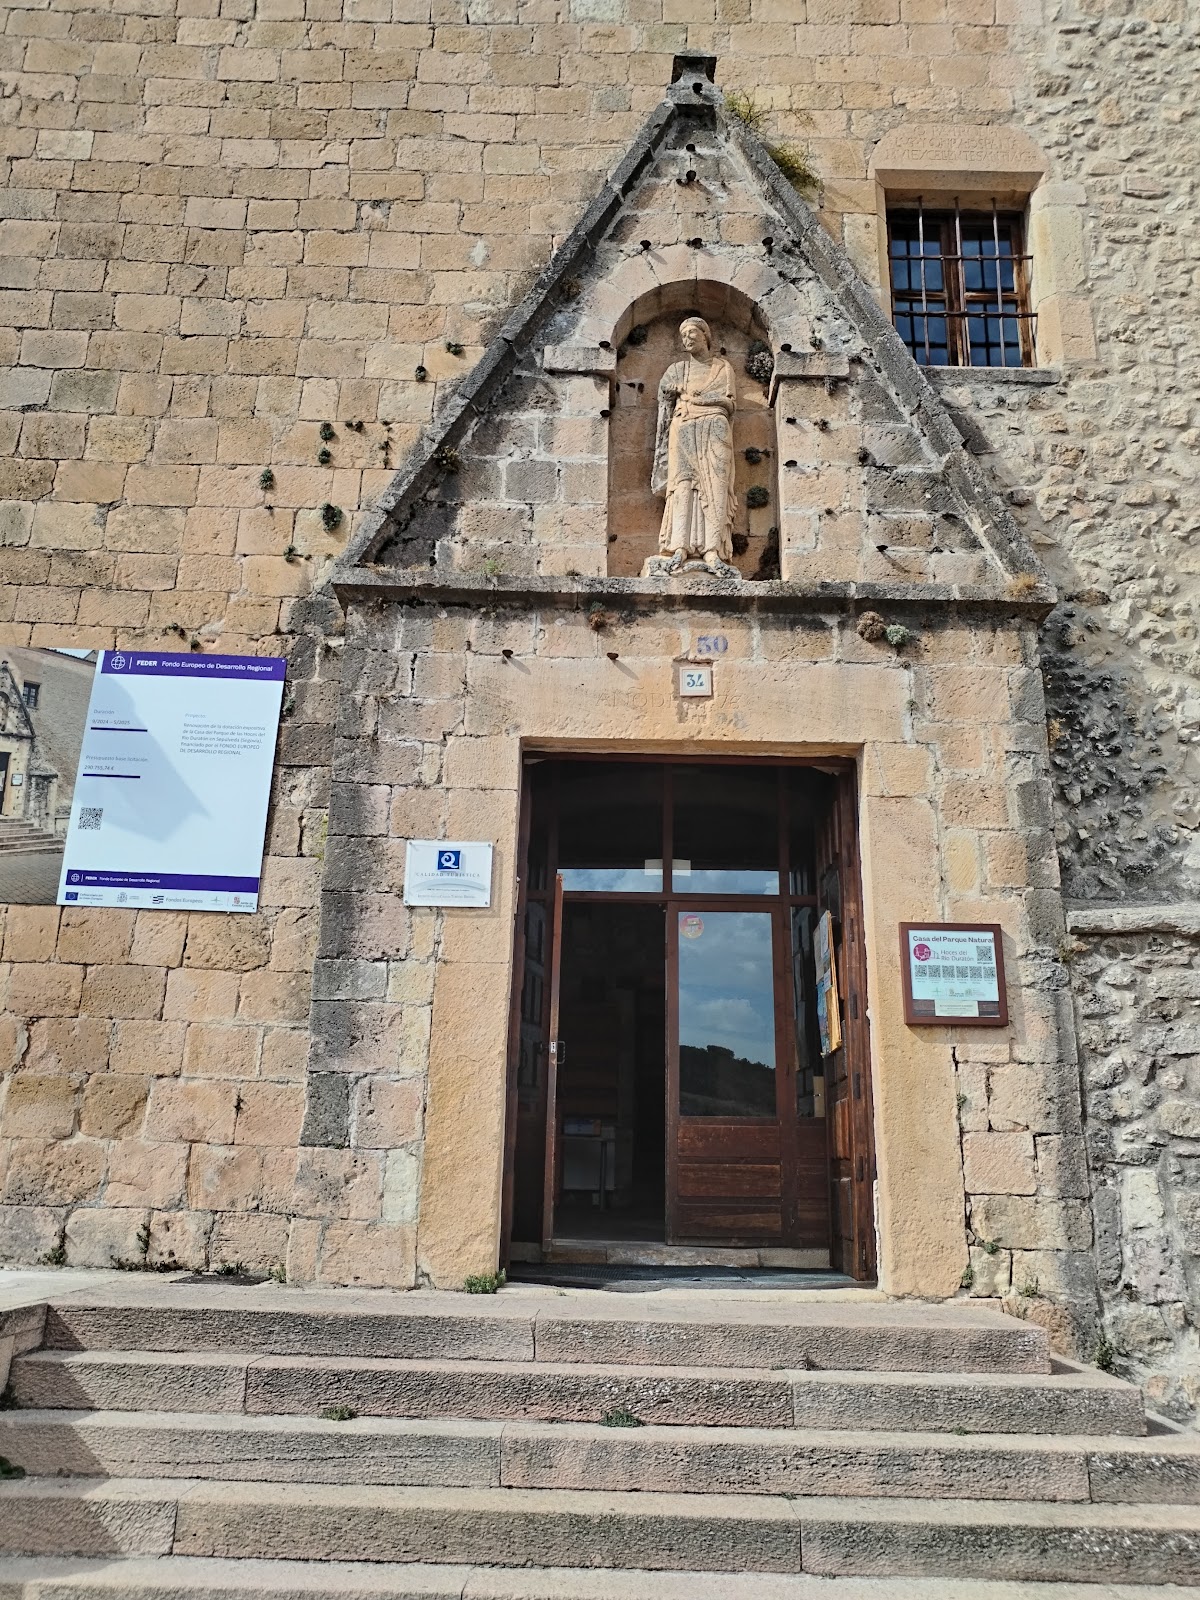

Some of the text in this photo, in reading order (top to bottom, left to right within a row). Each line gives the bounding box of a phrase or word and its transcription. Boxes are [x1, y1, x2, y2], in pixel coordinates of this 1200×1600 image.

[247, 664, 273, 672] Regional
[686, 674, 704, 688] 34
[441, 852, 458, 868] Q
